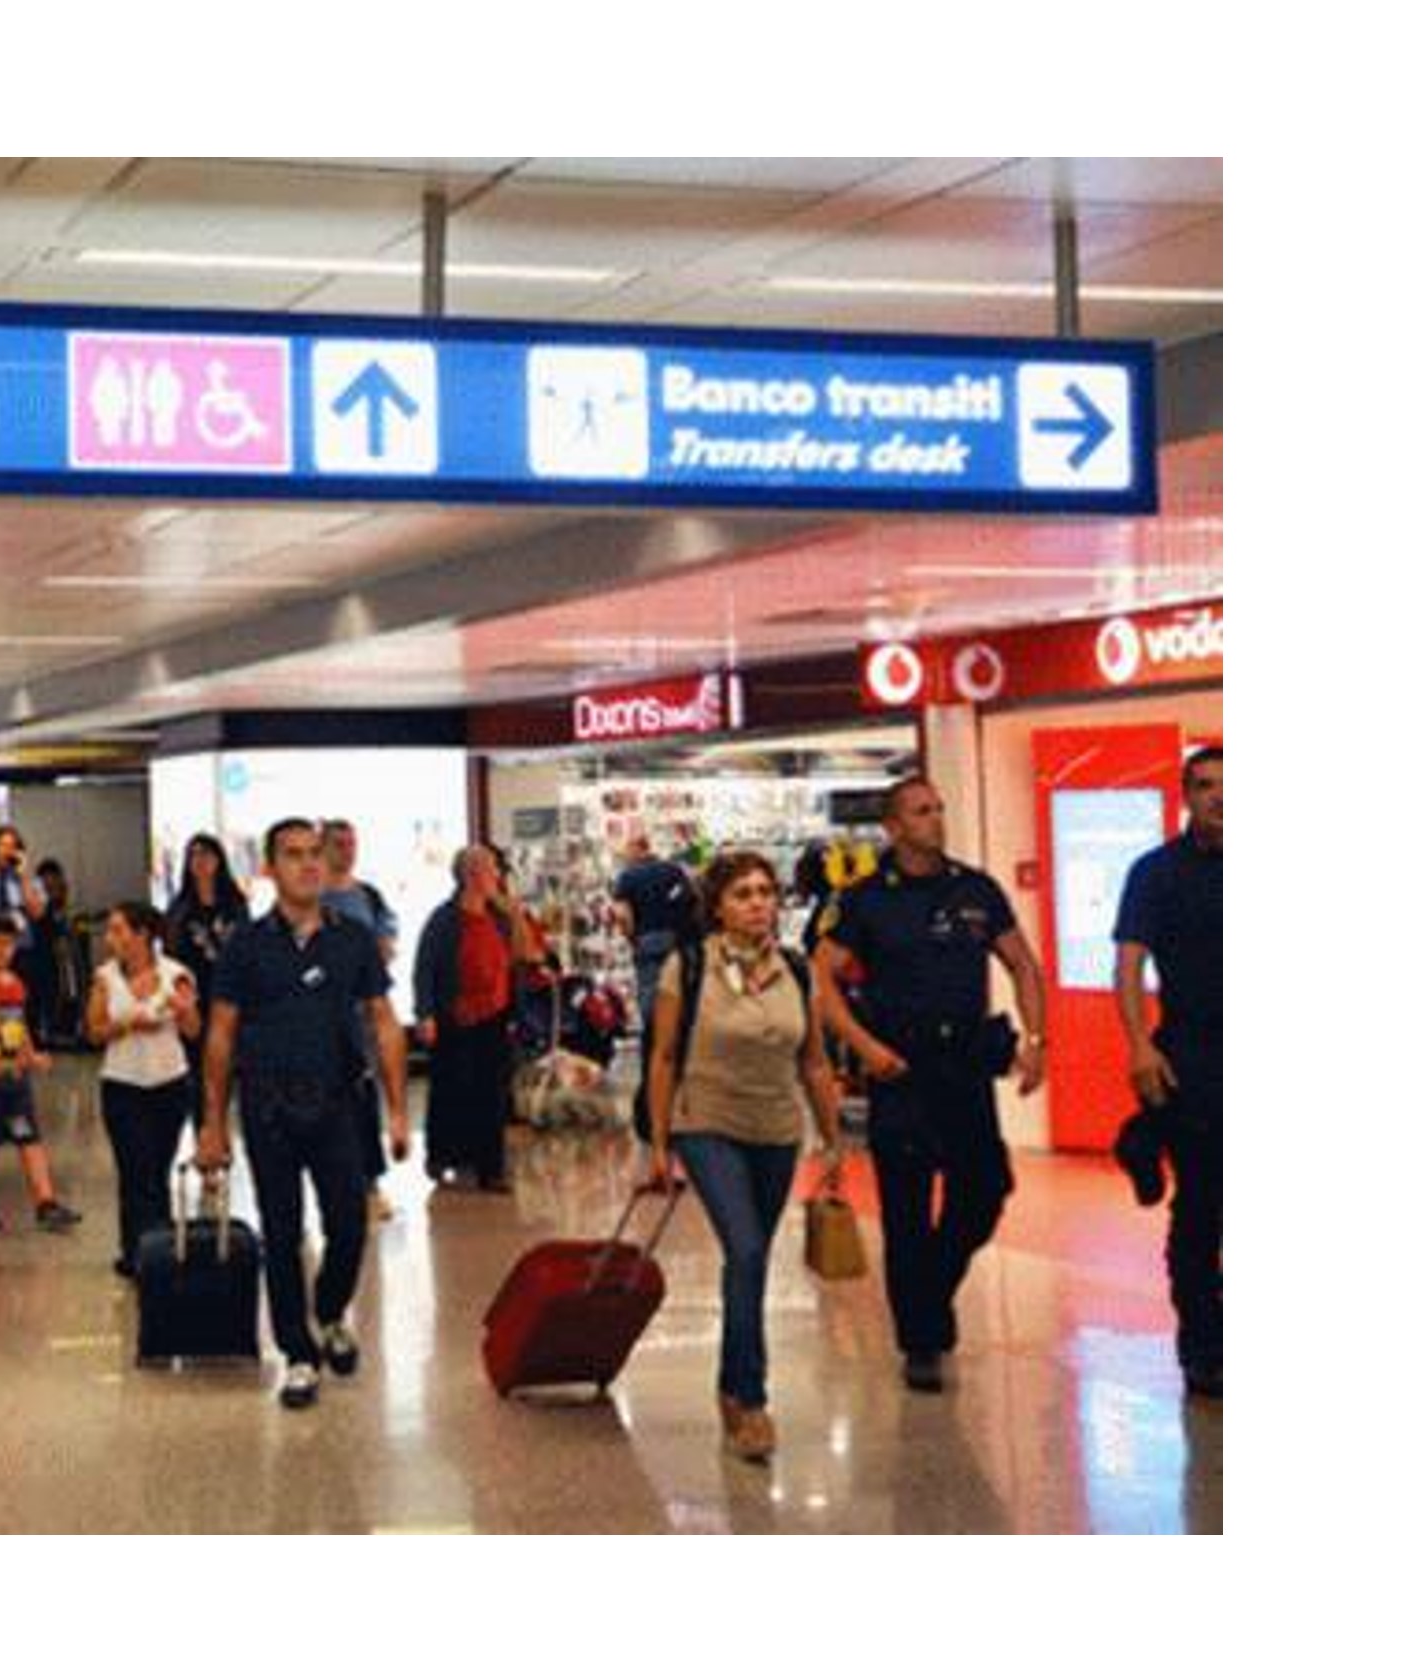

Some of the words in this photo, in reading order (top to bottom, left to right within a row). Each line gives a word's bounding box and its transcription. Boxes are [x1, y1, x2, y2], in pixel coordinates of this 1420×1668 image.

[663, 364, 816, 415] Banco
[827, 374, 1003, 422] transiti
[670, 427, 861, 471] Transfers
[869, 432, 971, 475] desk
